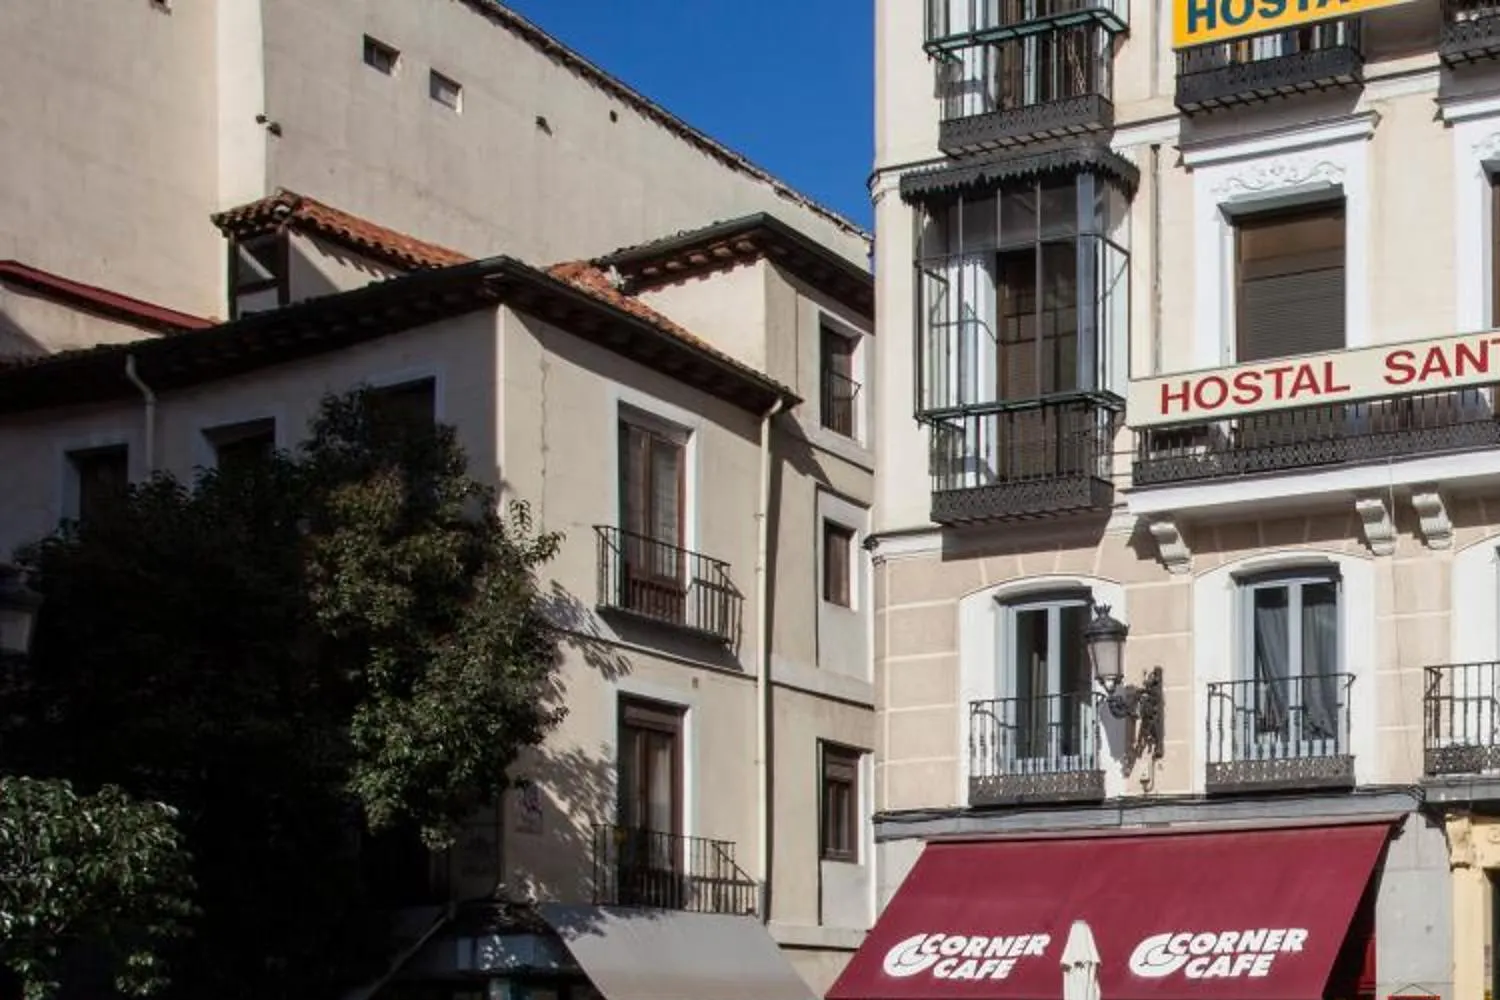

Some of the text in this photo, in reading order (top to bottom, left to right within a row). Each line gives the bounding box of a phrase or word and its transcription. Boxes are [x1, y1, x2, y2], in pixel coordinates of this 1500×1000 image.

[1160, 362, 1351, 416] HOSTAL
[921, 933, 1052, 958] CORNER
[1167, 927, 1309, 954] CORNER
[932, 957, 1018, 980] CAFE
[1184, 953, 1276, 979] CAFE
